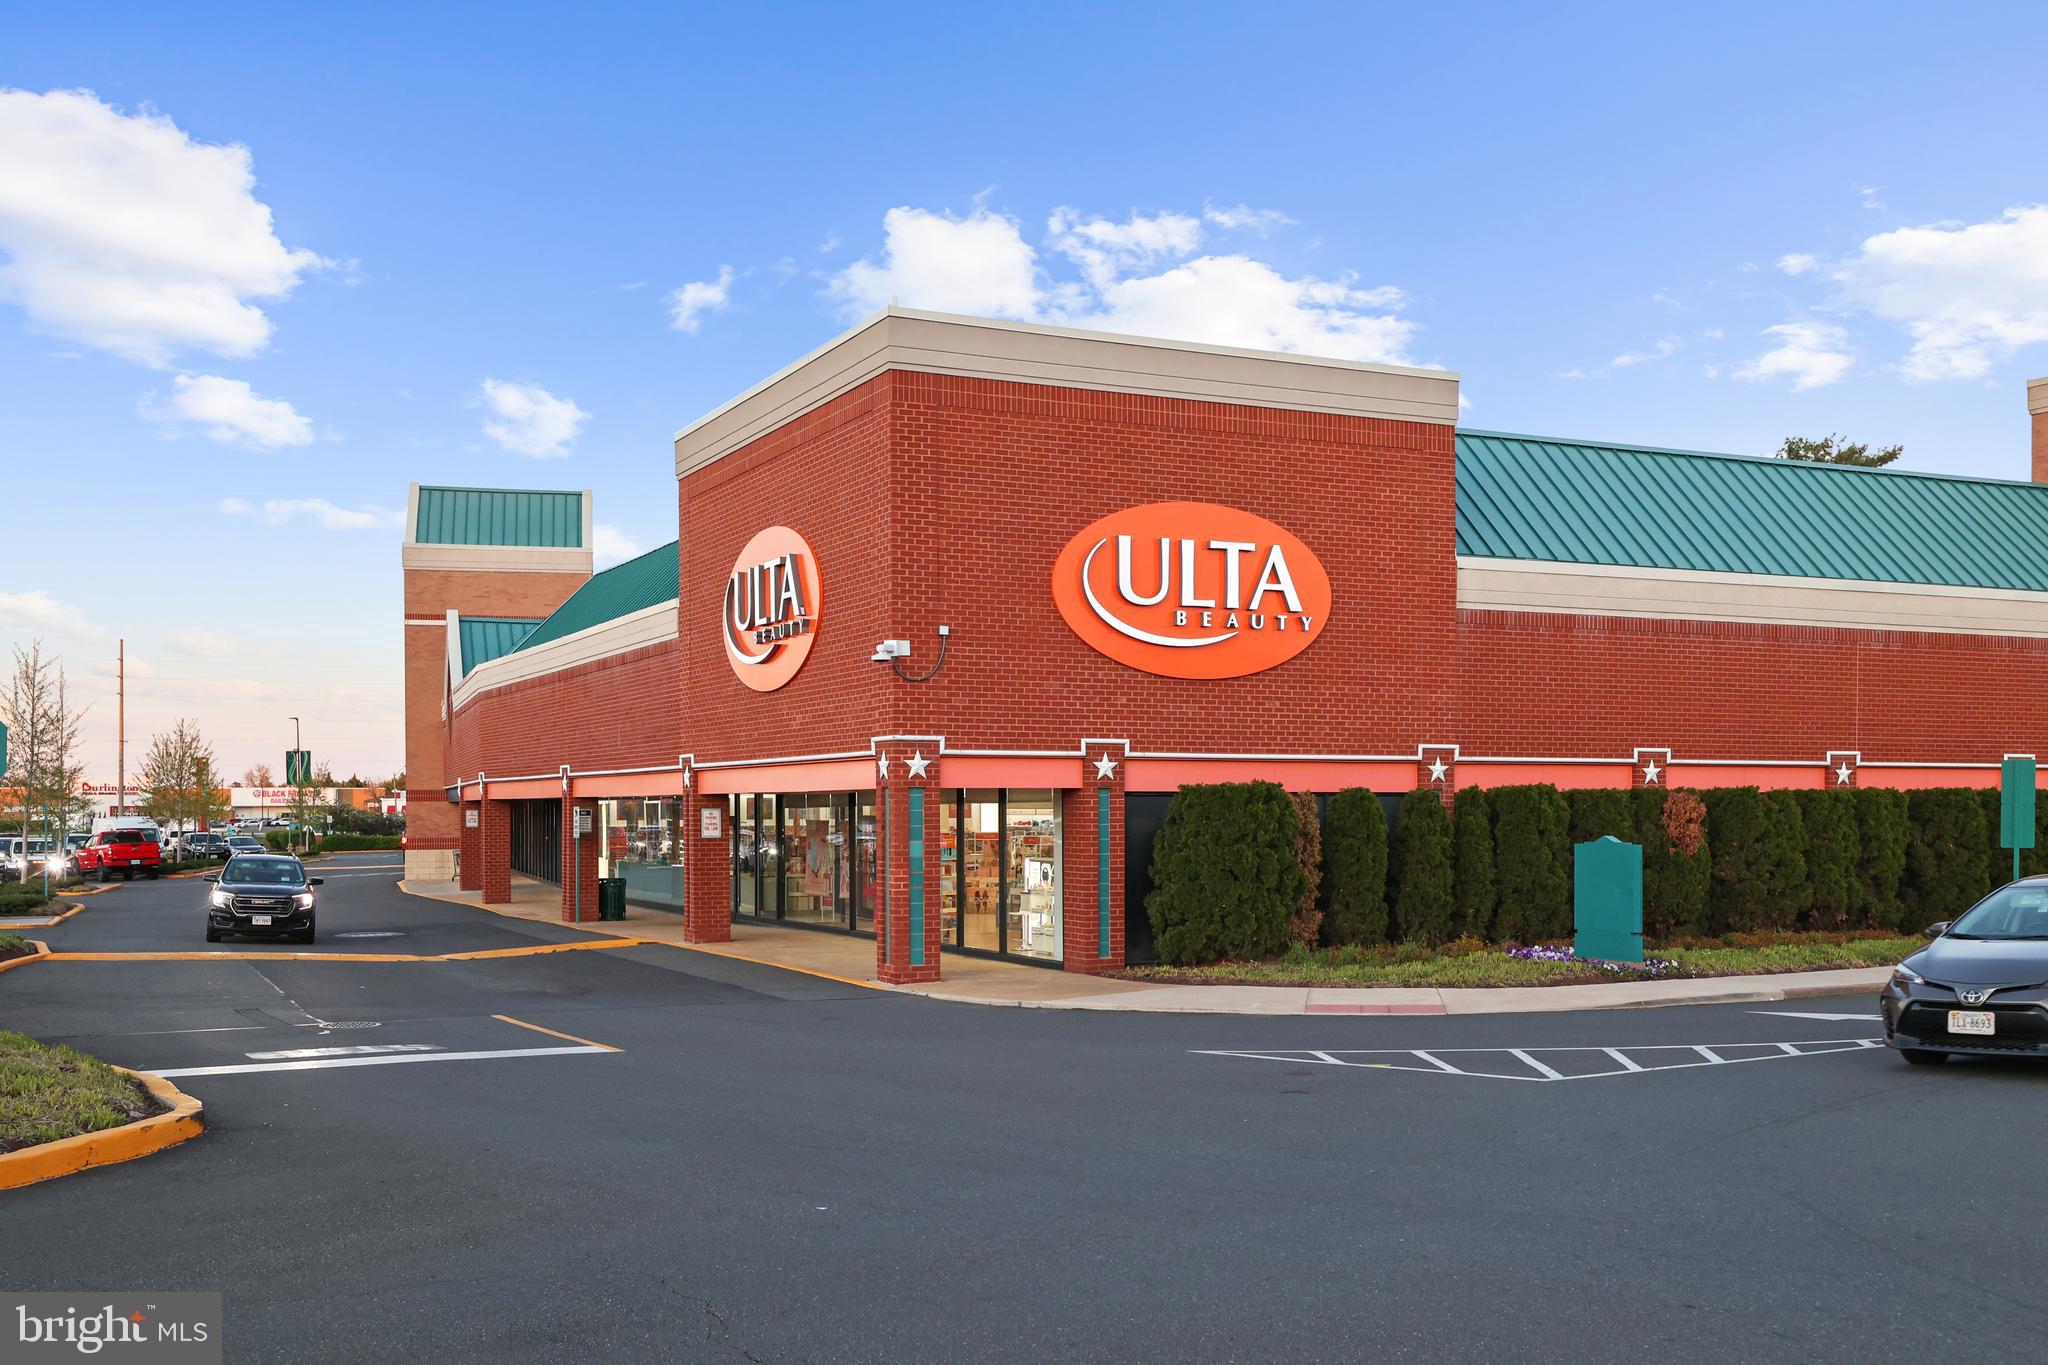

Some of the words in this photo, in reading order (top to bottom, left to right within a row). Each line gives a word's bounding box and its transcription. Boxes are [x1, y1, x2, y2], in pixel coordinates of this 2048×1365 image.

[1115, 534, 1303, 612] ULTA
[733, 553, 802, 632] ULTA
[752, 619, 809, 645] BEAUTY
[1173, 610, 1313, 632] BEAUTY
[82, 782, 139, 792] Burlinton
[262, 789, 286, 798] BLACK
